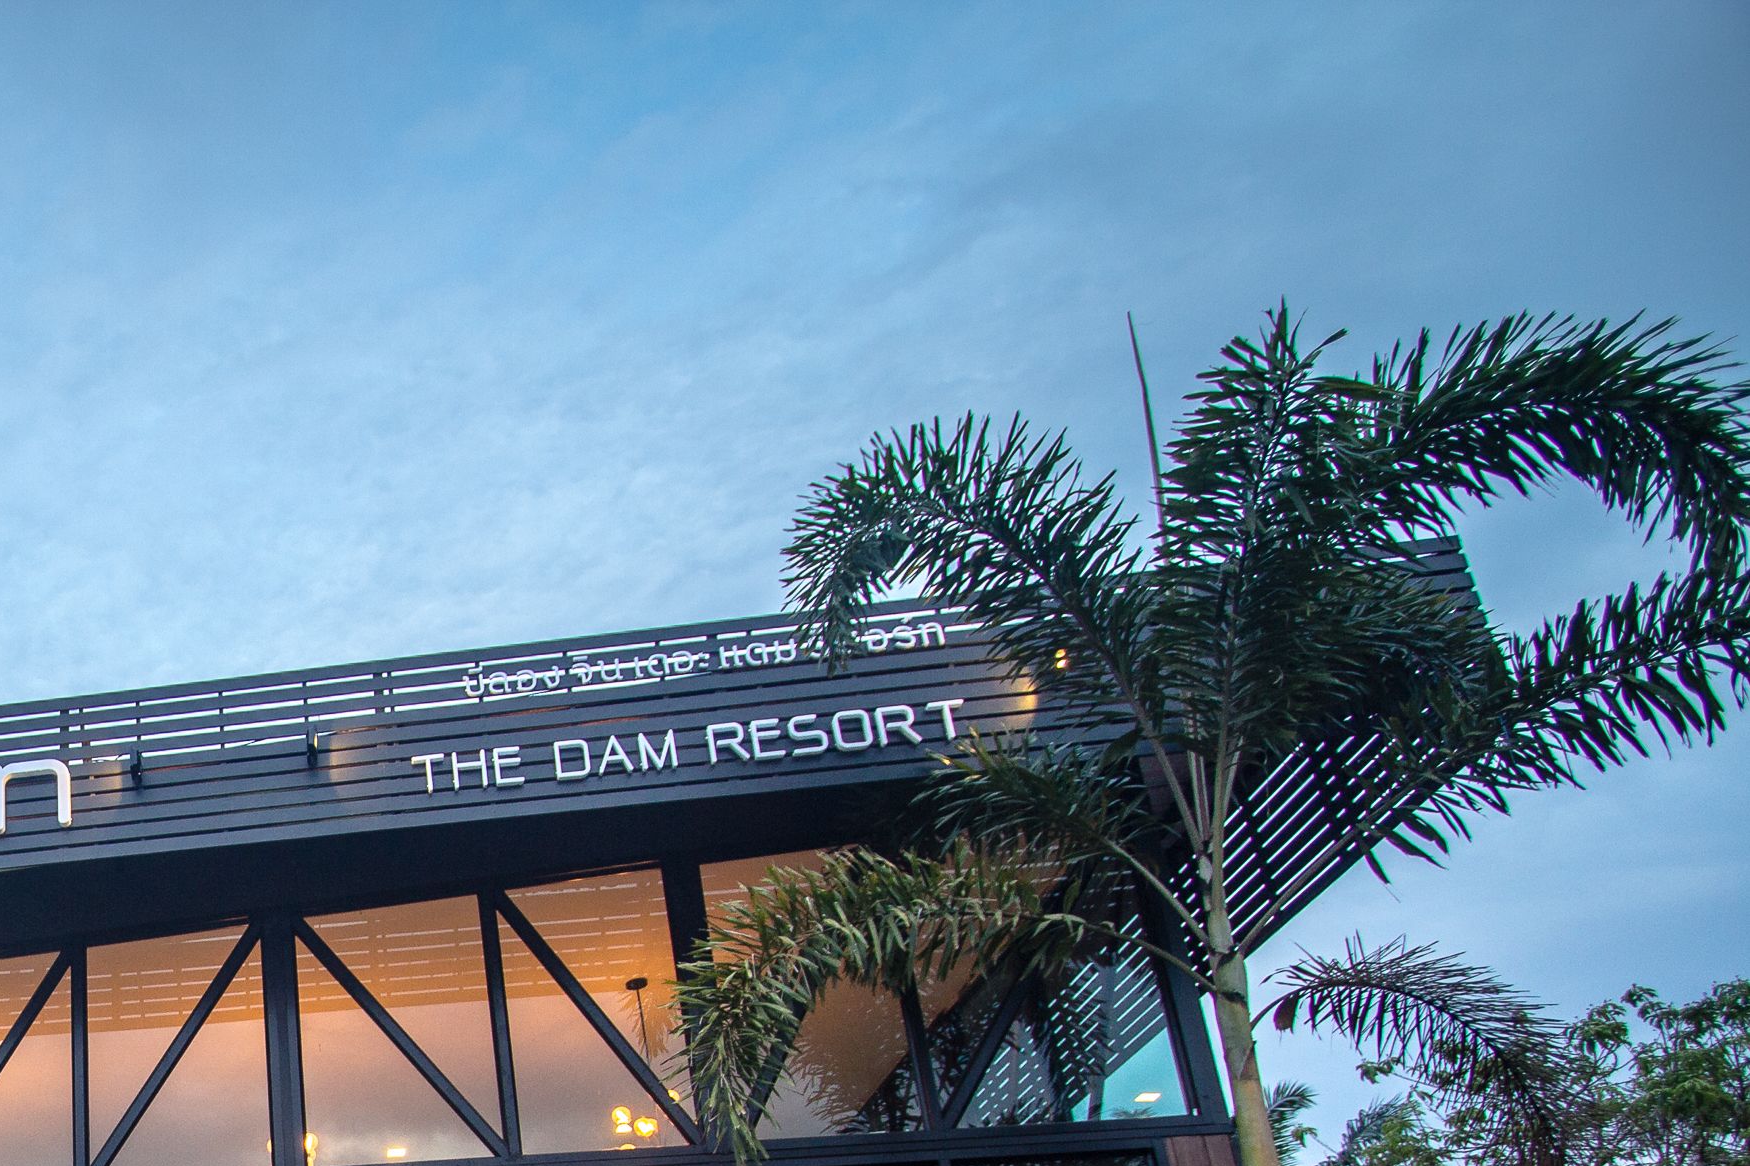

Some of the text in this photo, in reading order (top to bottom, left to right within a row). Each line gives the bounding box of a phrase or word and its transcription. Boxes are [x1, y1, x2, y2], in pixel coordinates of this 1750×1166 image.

[411, 698, 965, 795] THE DAM RESORT
